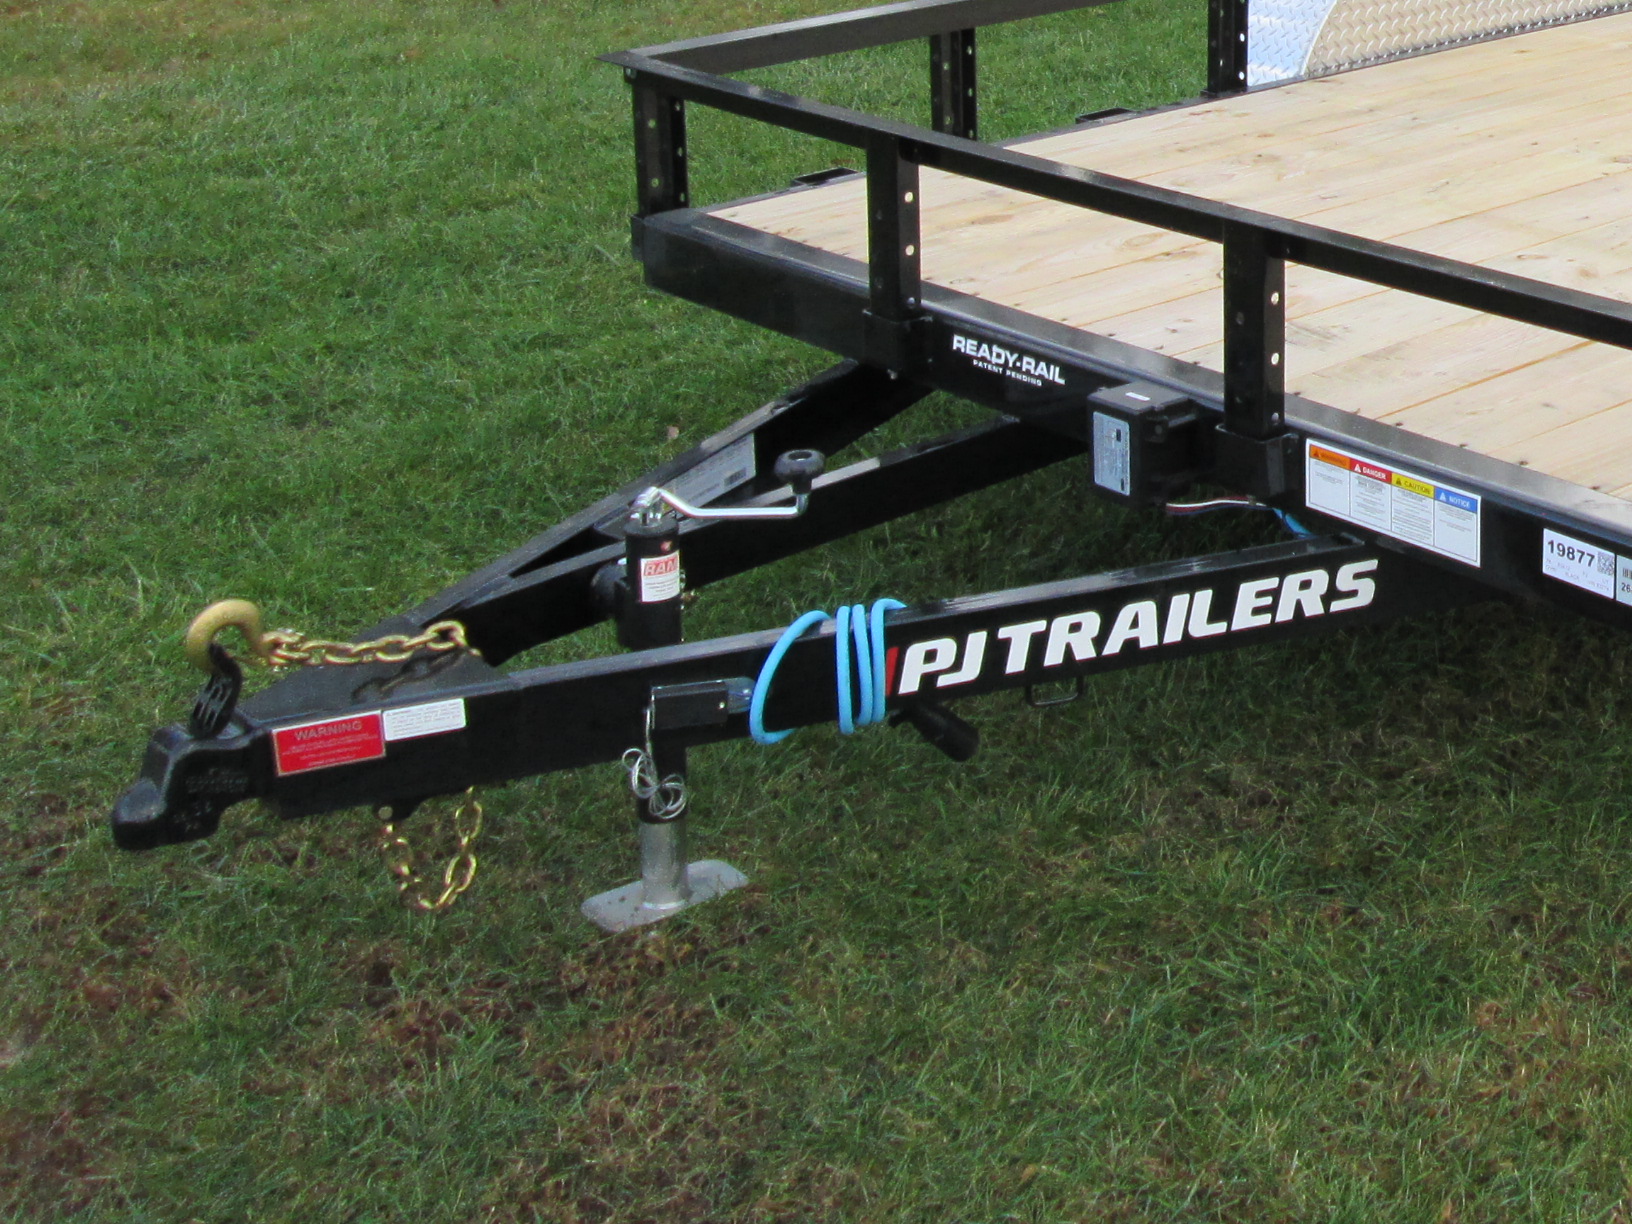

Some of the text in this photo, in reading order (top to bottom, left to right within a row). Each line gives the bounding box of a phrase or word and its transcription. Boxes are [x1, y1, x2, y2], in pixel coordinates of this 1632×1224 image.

[952, 334, 1065, 385] READY-RAIL
[972, 359, 1042, 387] PATENT PENDING
[1362, 466, 1387, 480] DANGER
[1404, 480, 1431, 495] CAUTION
[1449, 495, 1471, 509] NOTICE
[1547, 539, 1596, 567] 19877
[899, 558, 1379, 695] PJ TRAILERS
[294, 720, 363, 741] WARNING
